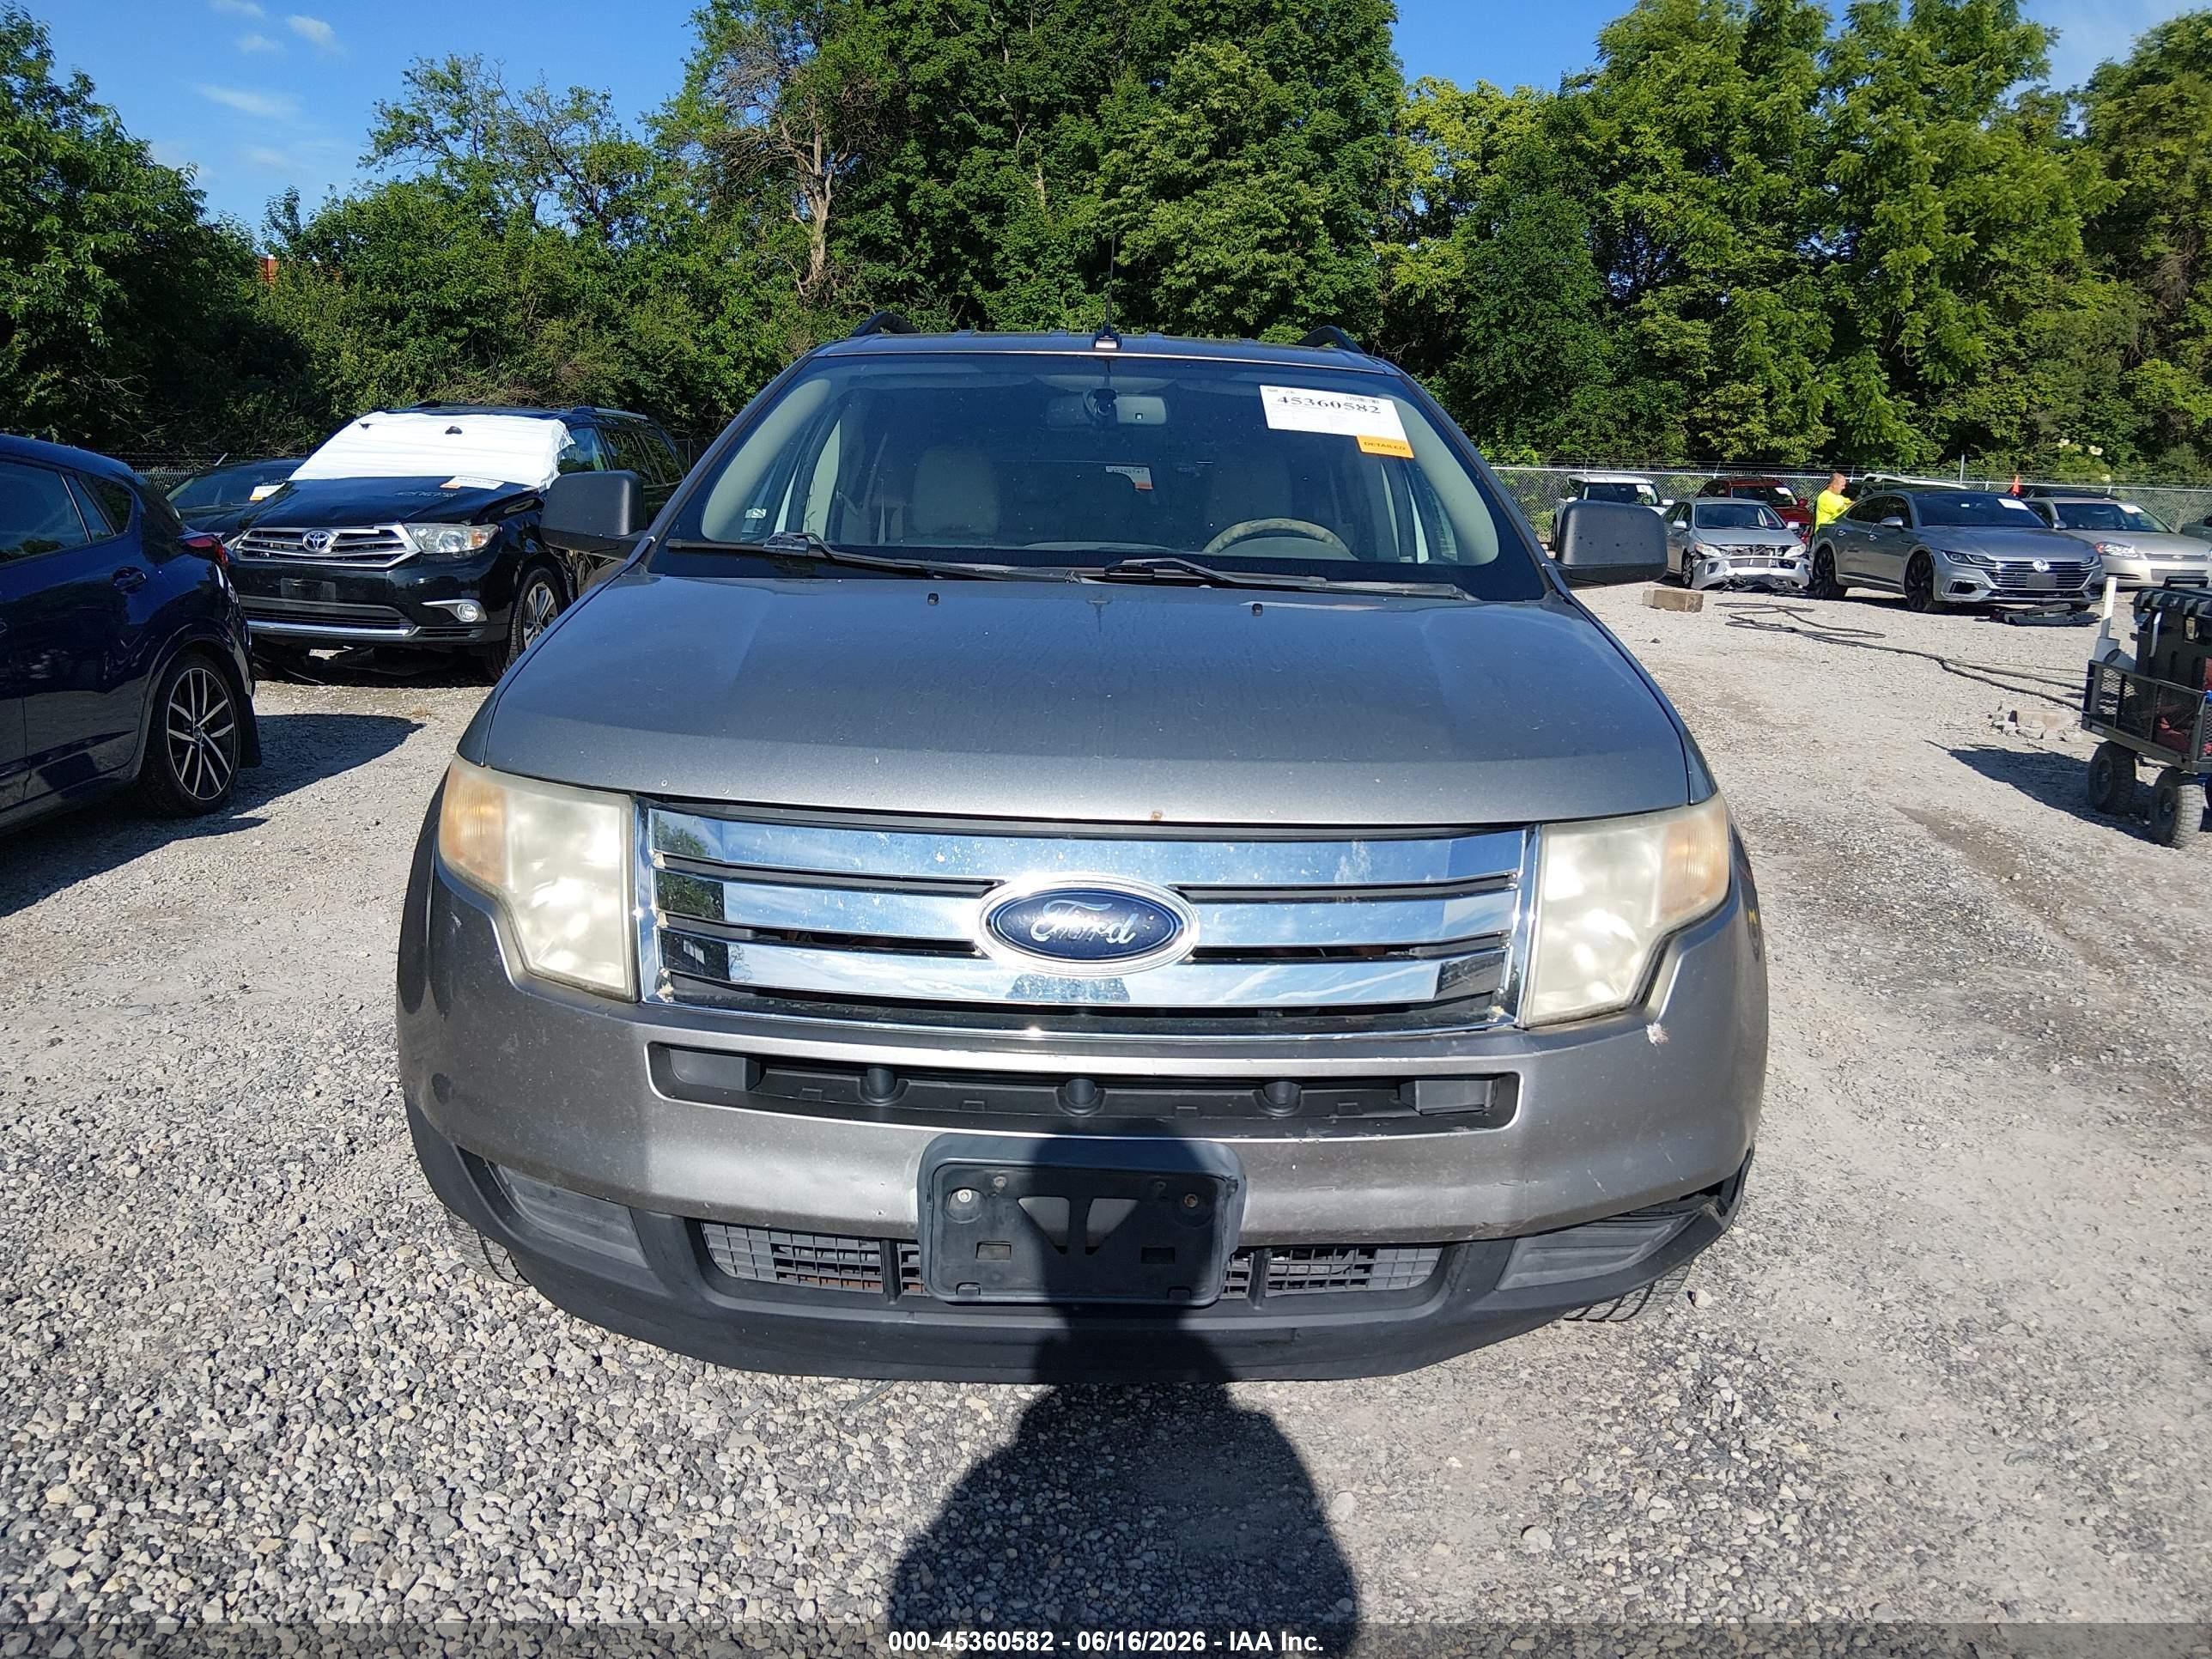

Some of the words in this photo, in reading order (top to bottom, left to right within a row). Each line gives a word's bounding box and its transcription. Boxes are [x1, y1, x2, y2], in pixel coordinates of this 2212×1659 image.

[1278, 396, 1382, 415] 45360582
[1364, 441, 1407, 451] DETAILED
[1030, 898, 1139, 945] Ford
